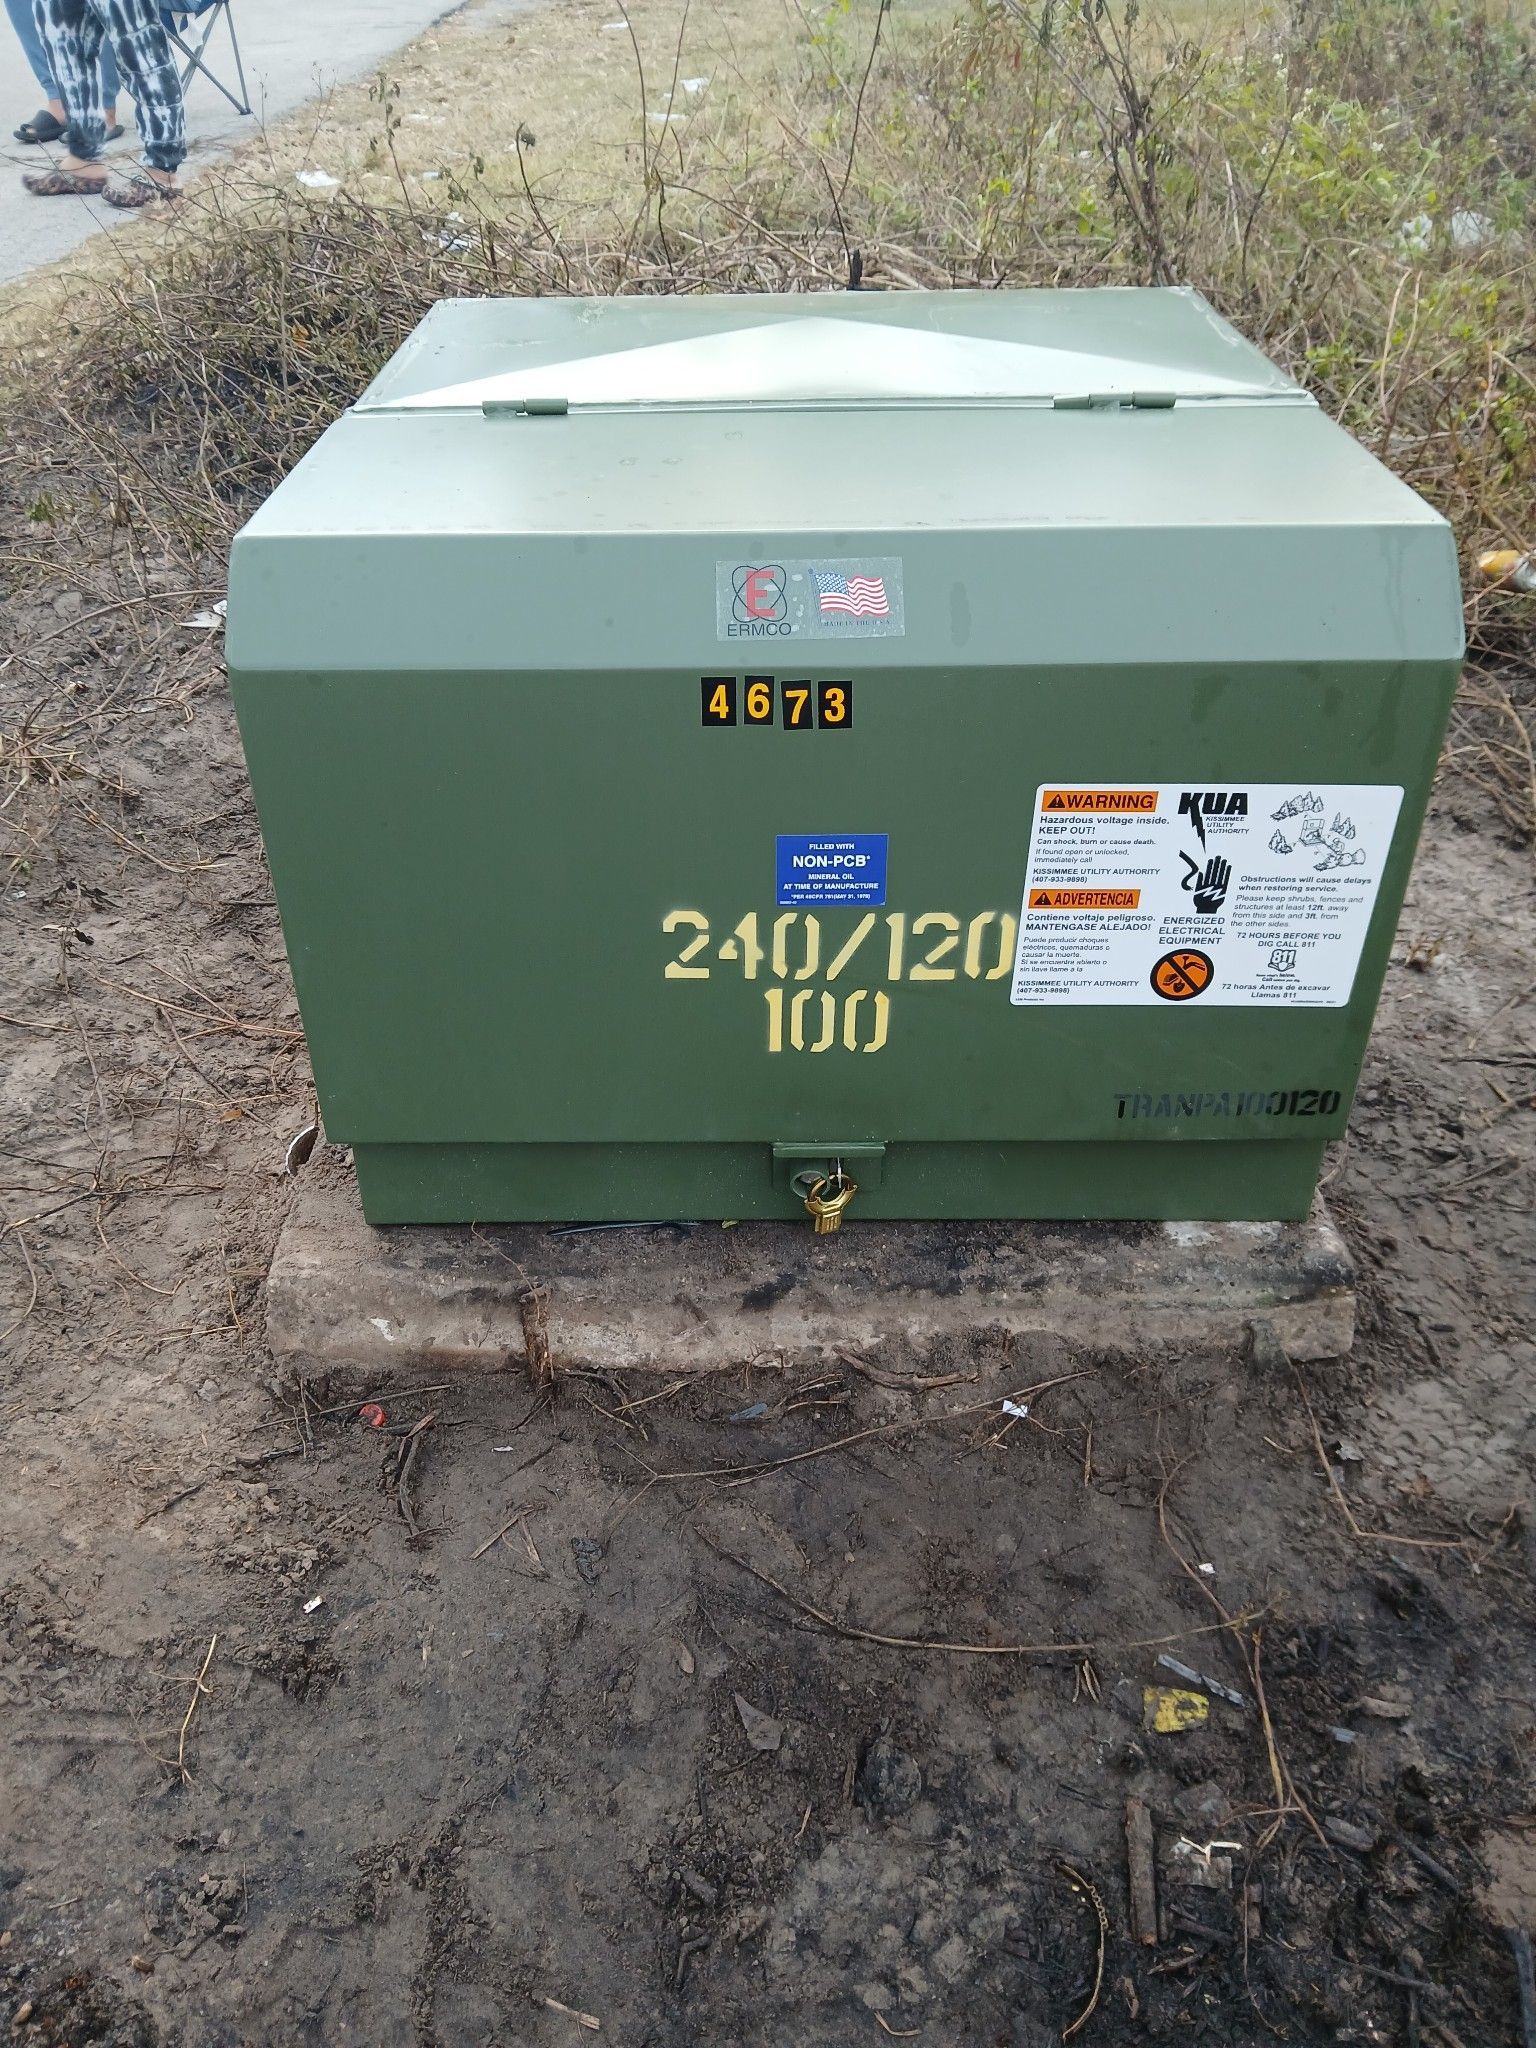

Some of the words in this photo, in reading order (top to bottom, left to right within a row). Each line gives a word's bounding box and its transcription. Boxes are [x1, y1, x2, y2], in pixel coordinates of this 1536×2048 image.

[746, 570, 775, 617] E
[727, 623, 792, 637] ERMCO
[709, 682, 846, 724] 4673
[1066, 794, 1154, 809] WARNING
[1178, 792, 1248, 815] KUA
[1040, 816, 1094, 824] Hazardous
[1096, 816, 1133, 826] voltage
[1136, 816, 1170, 825] inside.
[1038, 826, 1068, 834] KEEP
[1070, 826, 1095, 834] OUT!
[1240, 875, 1297, 883] Obstructions
[1343, 877, 1372, 885] delays
[824, 882, 879, 890] MANUFACTURE
[1263, 885, 1303, 893] restoring
[1054, 892, 1134, 906] ADVERTENCIA
[1236, 894, 1264, 902] Please
[1265, 895, 1286, 903] keep
[1027, 913, 1070, 921] Contiene
[1073, 913, 1105, 922] voltaje
[1107, 914, 1156, 923] peligroso.
[1163, 916, 1226, 925] ENERGIZED
[1025, 923, 1097, 931] MANTENGASE
[1099, 923, 1151, 931] ALEJADO!
[1158, 926, 1226, 935] ELECTRICAL
[1158, 936, 1222, 945] EQUIPMENT
[1282, 932, 1319, 940] BEFORE
[662, 910, 1016, 981] 240/120
[1271, 949, 1296, 964] 811
[764, 988, 890, 1053] 100
